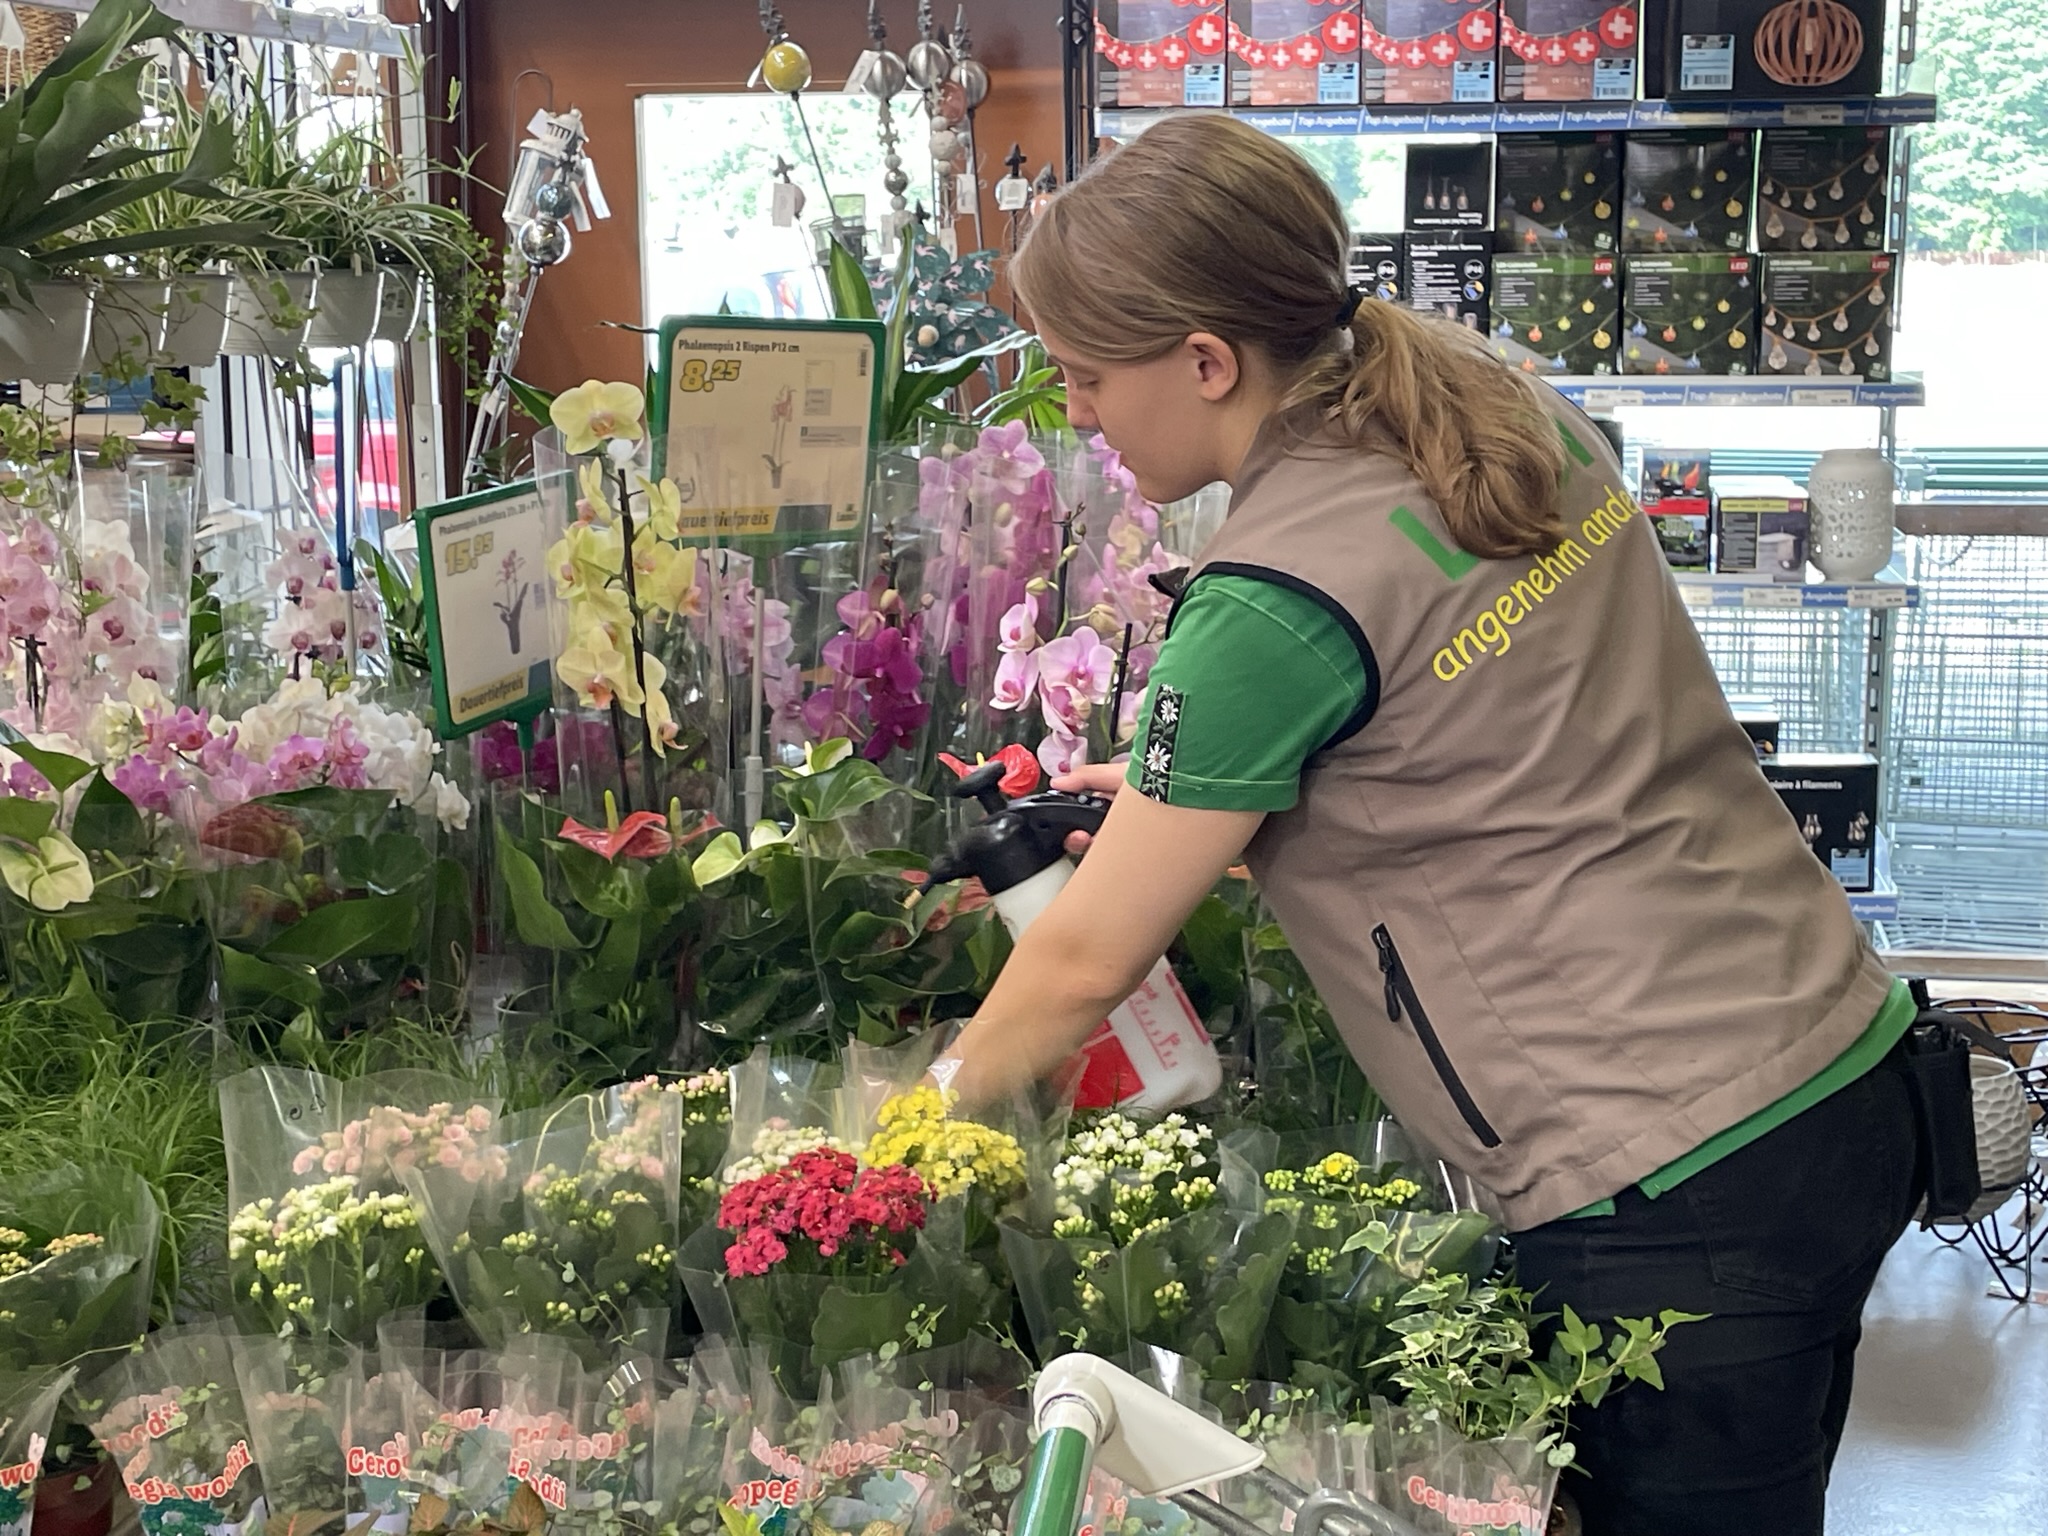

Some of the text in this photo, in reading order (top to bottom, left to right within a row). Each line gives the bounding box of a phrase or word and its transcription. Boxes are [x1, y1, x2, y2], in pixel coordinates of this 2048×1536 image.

[1316, 116, 1358, 128] Angebote
[1449, 114, 1491, 126] Angebote
[1594, 262, 1613, 272] LED
[1730, 261, 1749, 271] LED
[1871, 260, 1890, 270] LED
[735, 341, 742, 352] 2
[742, 341, 771, 354] Rispen
[771, 342, 787, 352] P12
[788, 345, 800, 353] cm
[680, 358, 742, 393] 8.25
[1432, 538, 1592, 682] angenehm
[1801, 778, 1843, 790] filaments
[1852, 903, 1896, 915] Angebote
